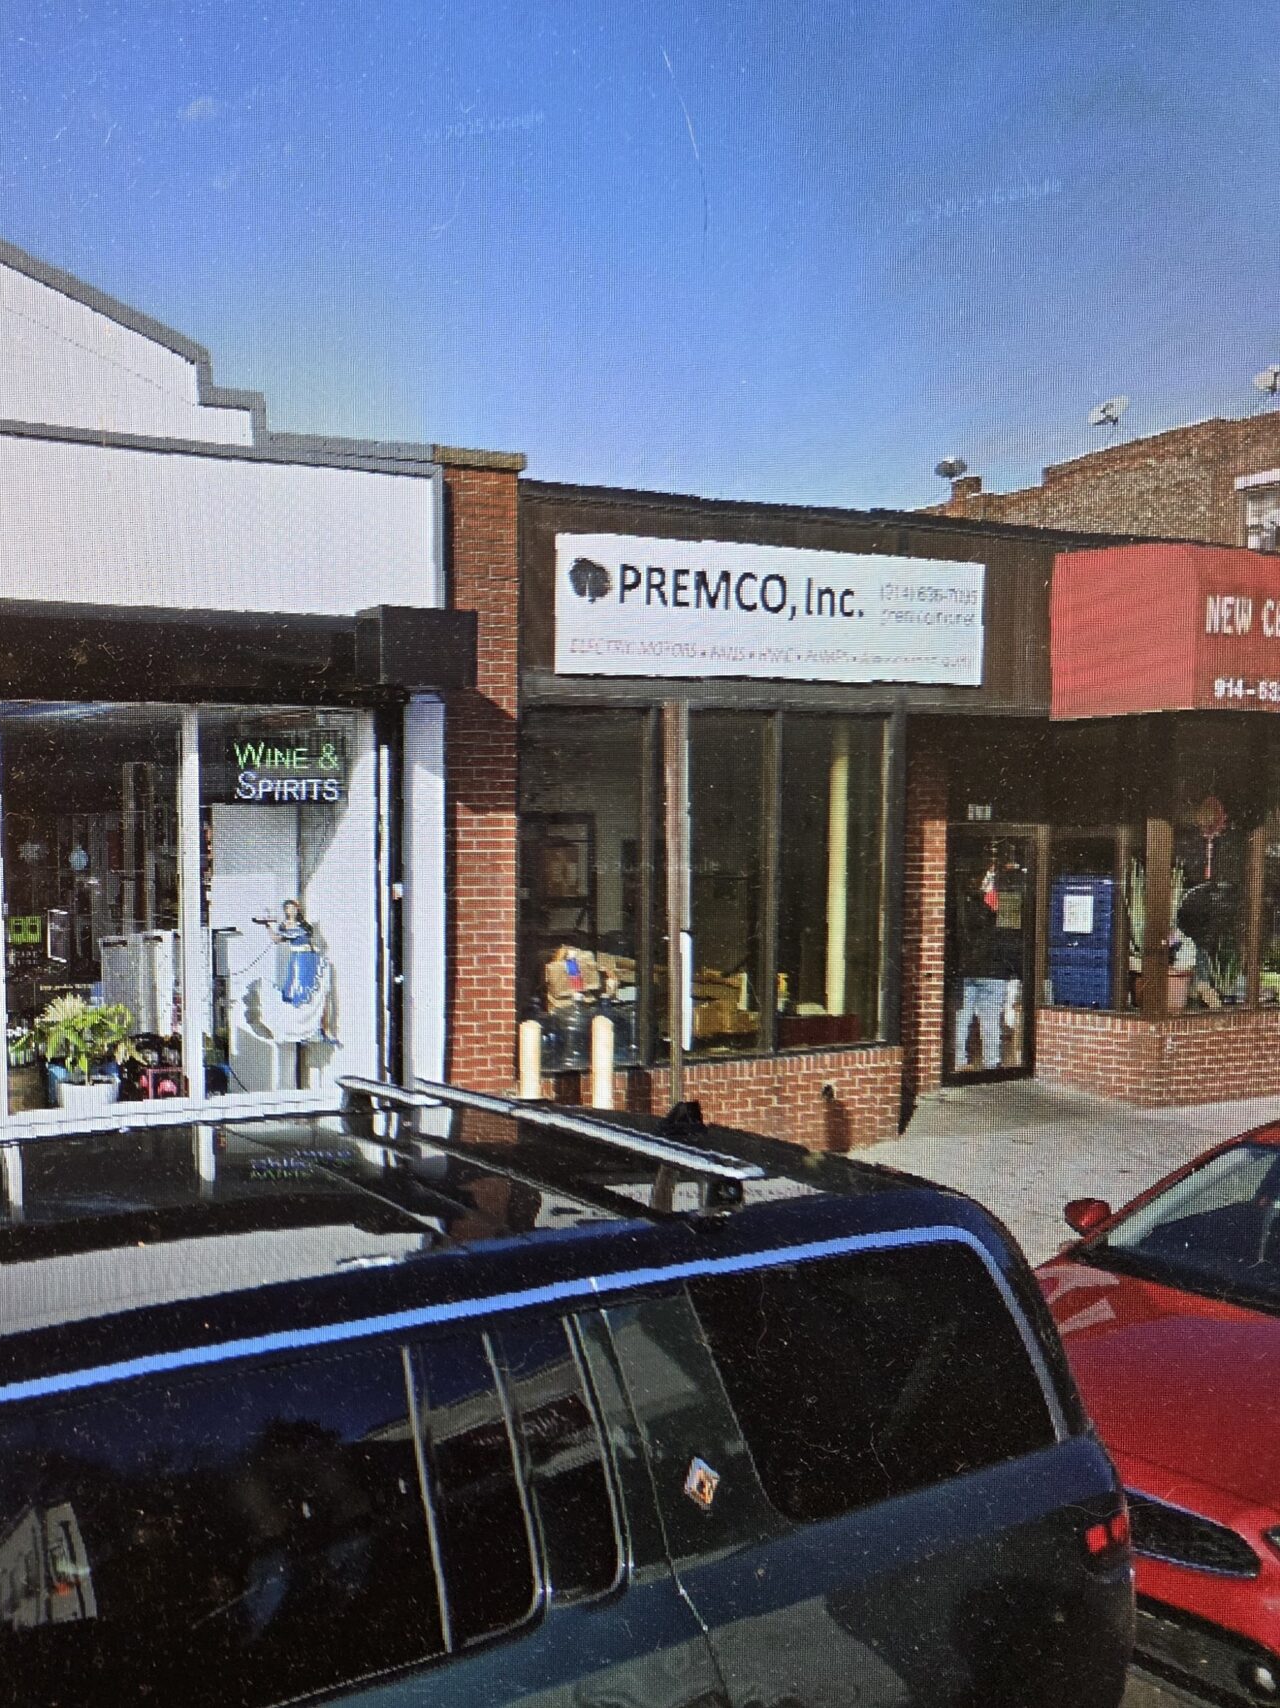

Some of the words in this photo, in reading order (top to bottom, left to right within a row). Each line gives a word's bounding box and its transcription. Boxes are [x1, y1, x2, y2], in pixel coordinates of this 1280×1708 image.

[805, 576, 865, 618] Inc.
[1205, 594, 1253, 636] NEW
[319, 742, 341, 771] &
